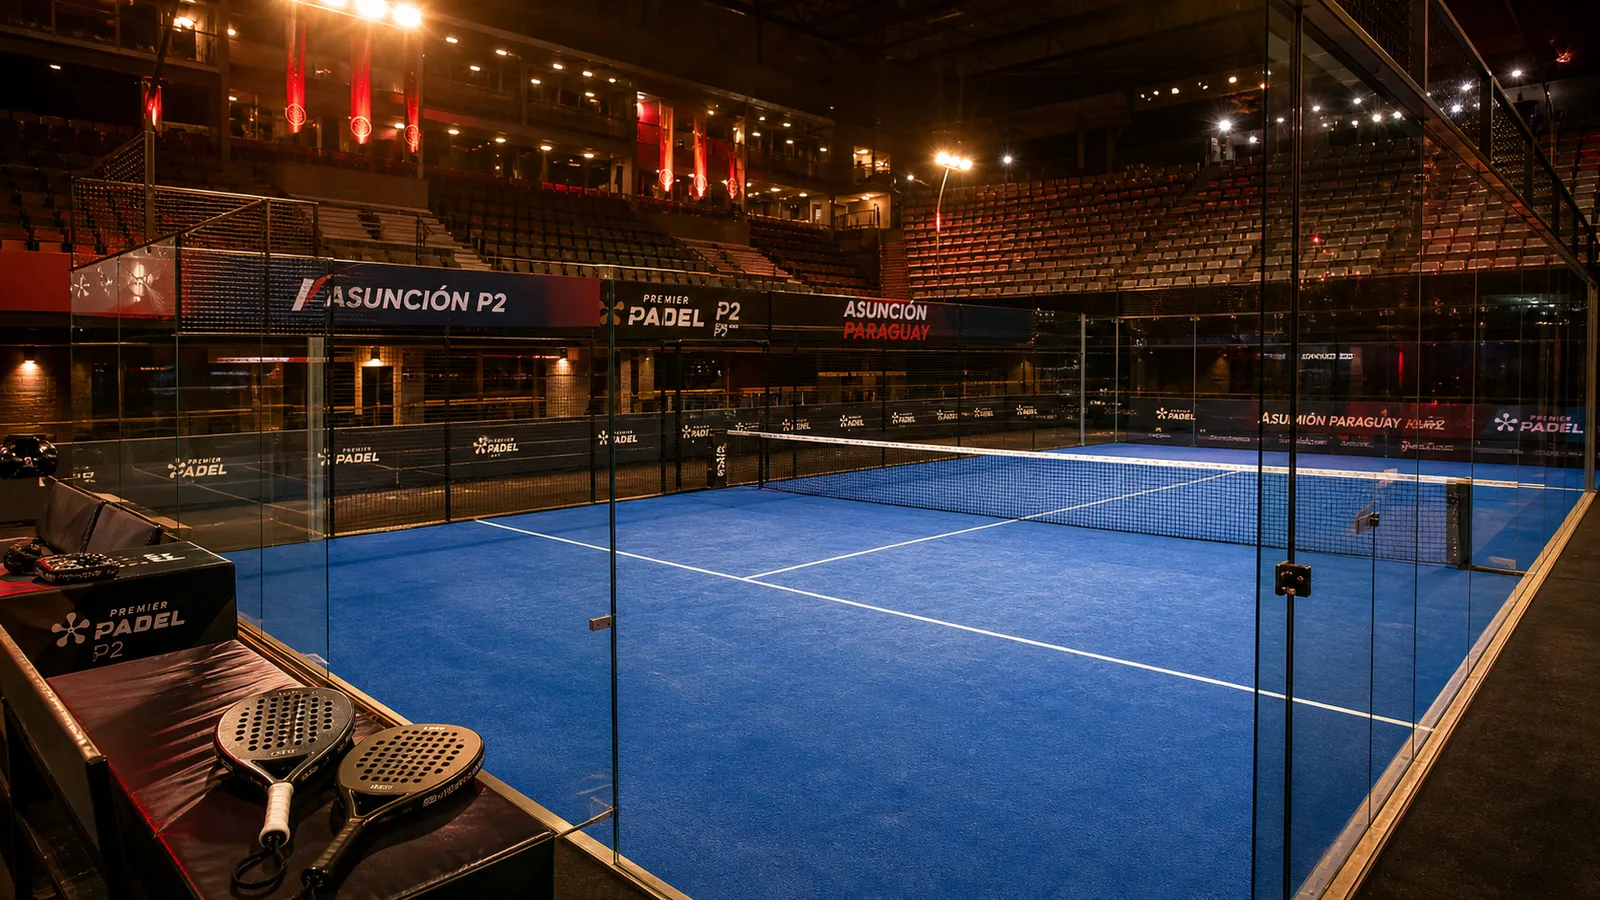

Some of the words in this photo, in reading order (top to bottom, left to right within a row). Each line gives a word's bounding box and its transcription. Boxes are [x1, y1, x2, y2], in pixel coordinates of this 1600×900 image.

[325, 285, 470, 312] ASUNCIÓN
[476, 292, 507, 313] P2
[643, 294, 689, 305] PREMIER
[628, 306, 705, 327] PADEL
[715, 301, 741, 321] P2
[843, 300, 927, 321] ASUNCIÓN
[843, 321, 931, 341] PARAGUAY
[1329, 415, 1402, 429] PARAGUAY
[1520, 421, 1584, 434] PADEL
[613, 434, 638, 443] ADEL
[487, 443, 519, 453] PADEL
[336, 452, 380, 464] PADEL
[110, 601, 168, 617] PREMIER
[94, 610, 185, 640] PADEL
[92, 641, 124, 662] P2
